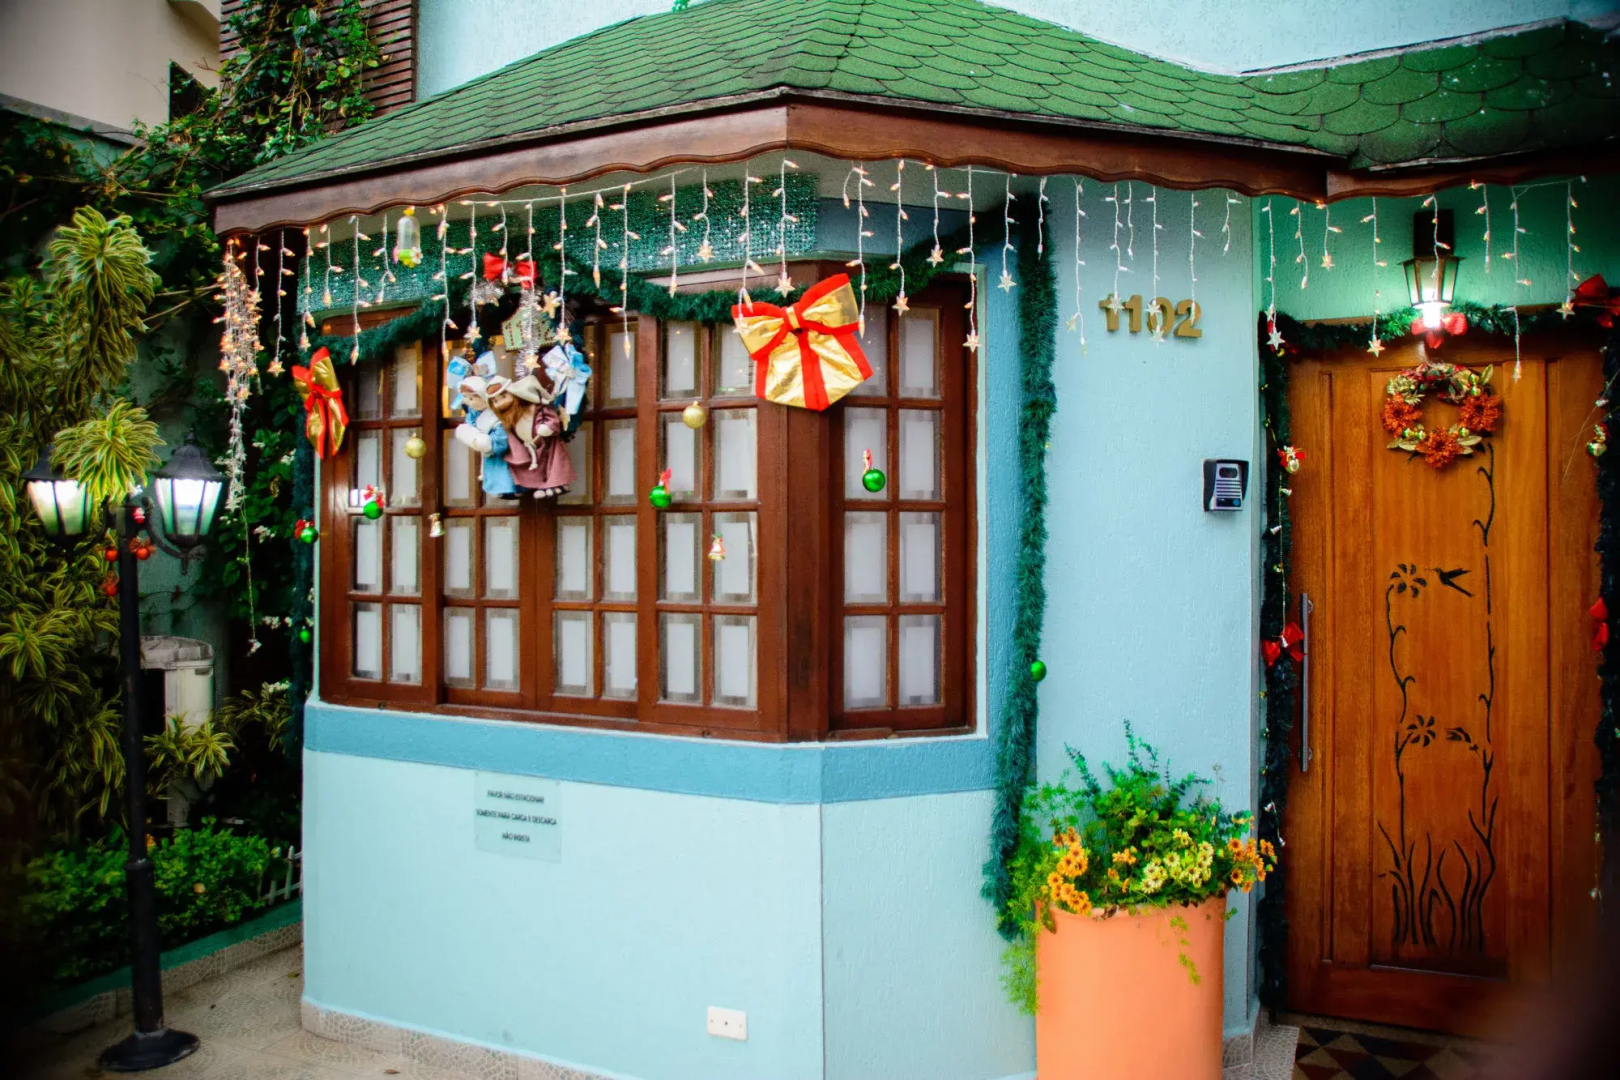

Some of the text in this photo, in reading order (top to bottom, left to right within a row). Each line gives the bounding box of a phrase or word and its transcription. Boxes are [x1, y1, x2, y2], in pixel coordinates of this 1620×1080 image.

[1099, 293, 1202, 339] 1102
[476, 809, 497, 818] SOMENTE
[498, 811, 510, 819] PARA
[512, 812, 527, 822] CARGA
[532, 815, 557, 825] DESCARGA
